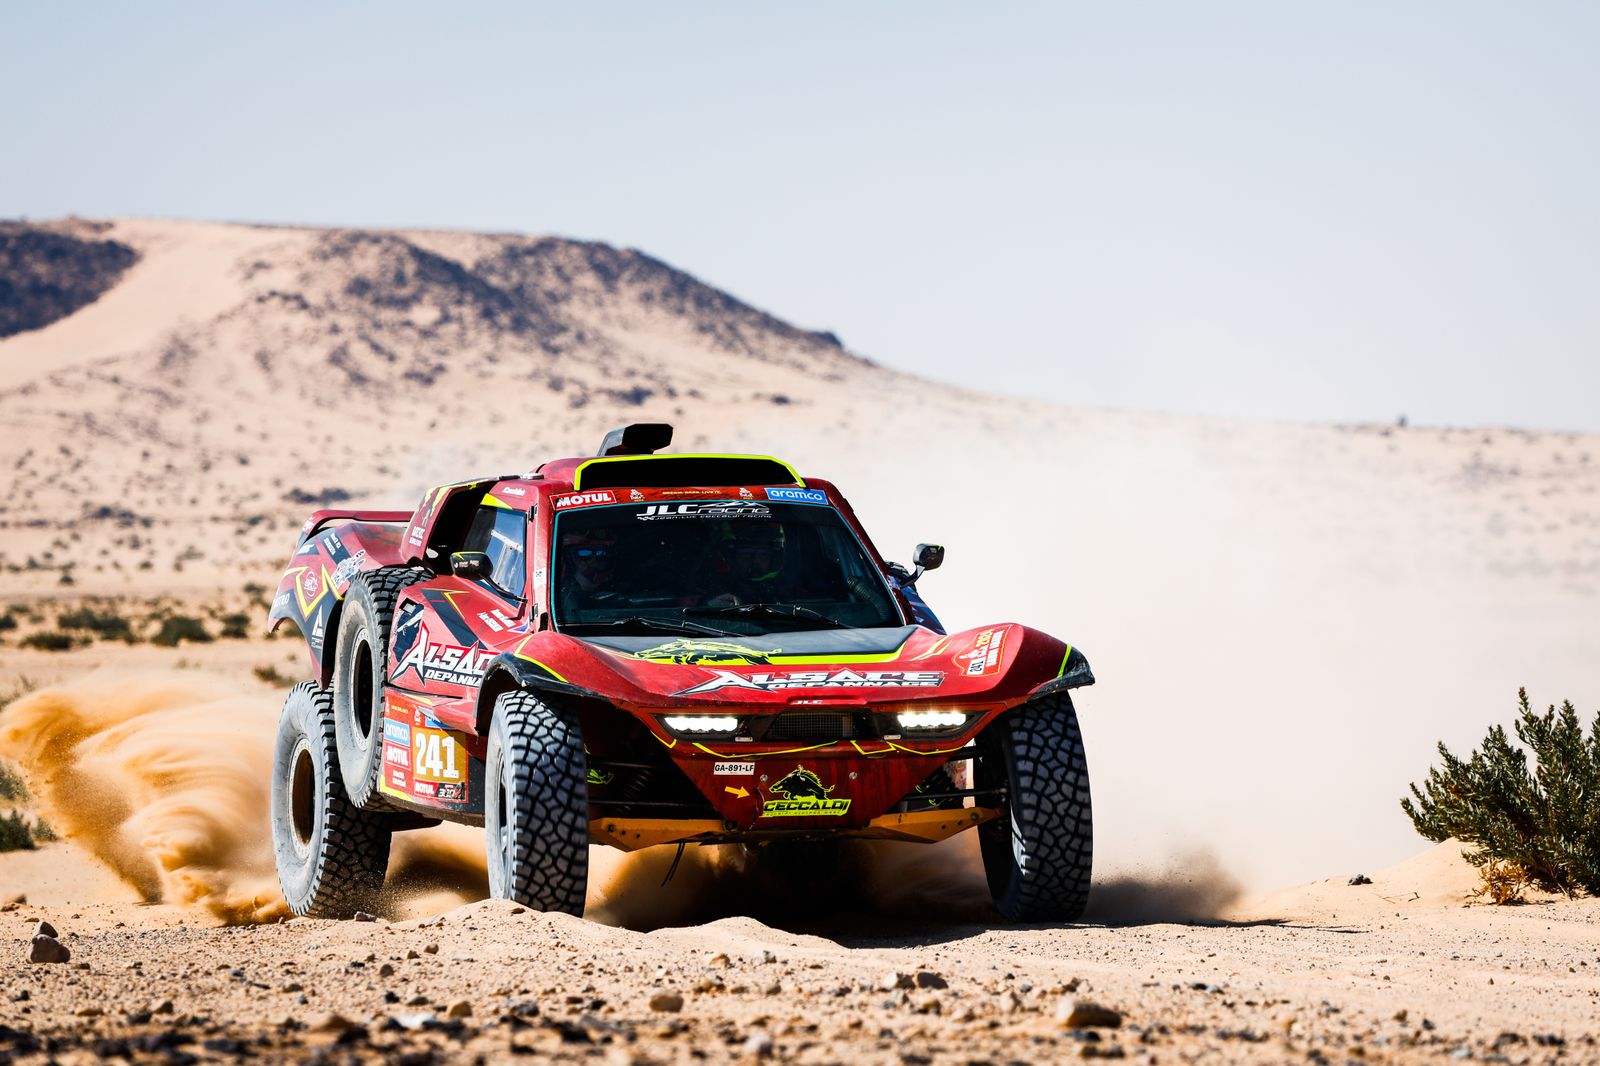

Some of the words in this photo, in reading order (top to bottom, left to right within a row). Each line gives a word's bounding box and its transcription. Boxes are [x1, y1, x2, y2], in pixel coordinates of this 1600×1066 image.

[556, 493, 612, 507] MOTUL
[770, 490, 823, 501] aramco
[637, 504, 698, 516] JLC
[389, 621, 501, 687] ALSAC
[969, 660, 984, 672] 241
[424, 669, 483, 686] DEPANNA
[670, 669, 942, 696] ALSACE
[385, 723, 408, 741] aramco
[386, 745, 409, 766] MOTUL
[415, 732, 460, 779] 241
[714, 764, 754, 772] GA-891-LF
[415, 782, 435, 795] MOTUL
[764, 801, 848, 811] CECCALDI
